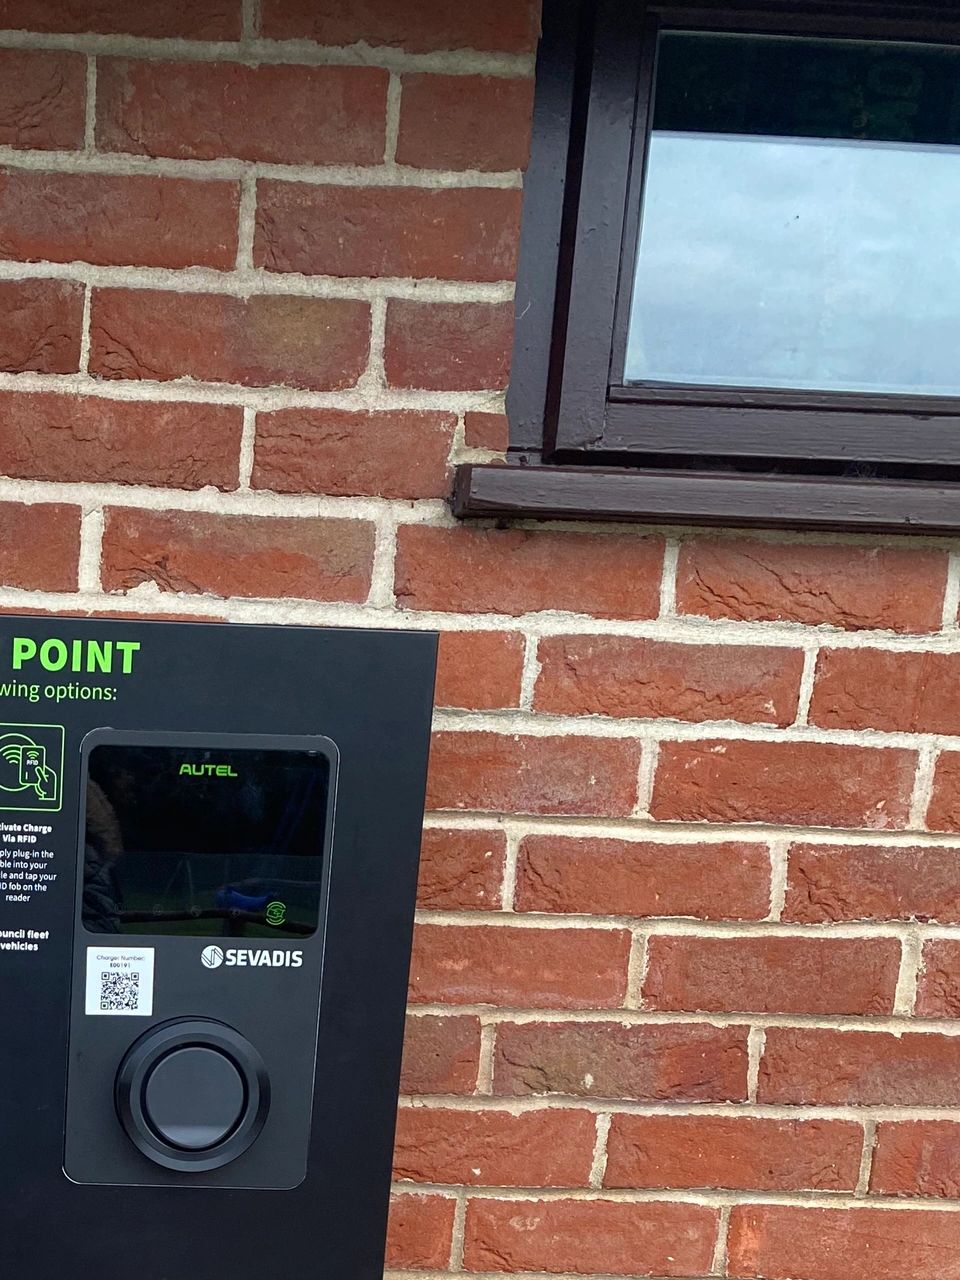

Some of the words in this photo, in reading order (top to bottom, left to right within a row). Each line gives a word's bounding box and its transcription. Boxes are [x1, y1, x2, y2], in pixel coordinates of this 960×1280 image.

[12, 637, 140, 674] POINT
[44, 682, 117, 703] options:
[179, 763, 238, 777] AUTEL
[23, 824, 52, 834] Charge
[2, 834, 16, 842] Via
[17, 835, 37, 843] RFID
[13, 849, 39, 859] plug-in
[41, 850, 54, 858] the
[13, 860, 28, 868] into
[9, 871, 24, 879] and
[25, 873, 38, 881] tap
[9, 882, 21, 890] fob
[34, 883, 47, 891] the
[6, 893, 31, 901] reader
[27, 930, 49, 939] fleet
[0, 941, 38, 951] vehicles
[225, 950, 303, 968] SEVADIS
